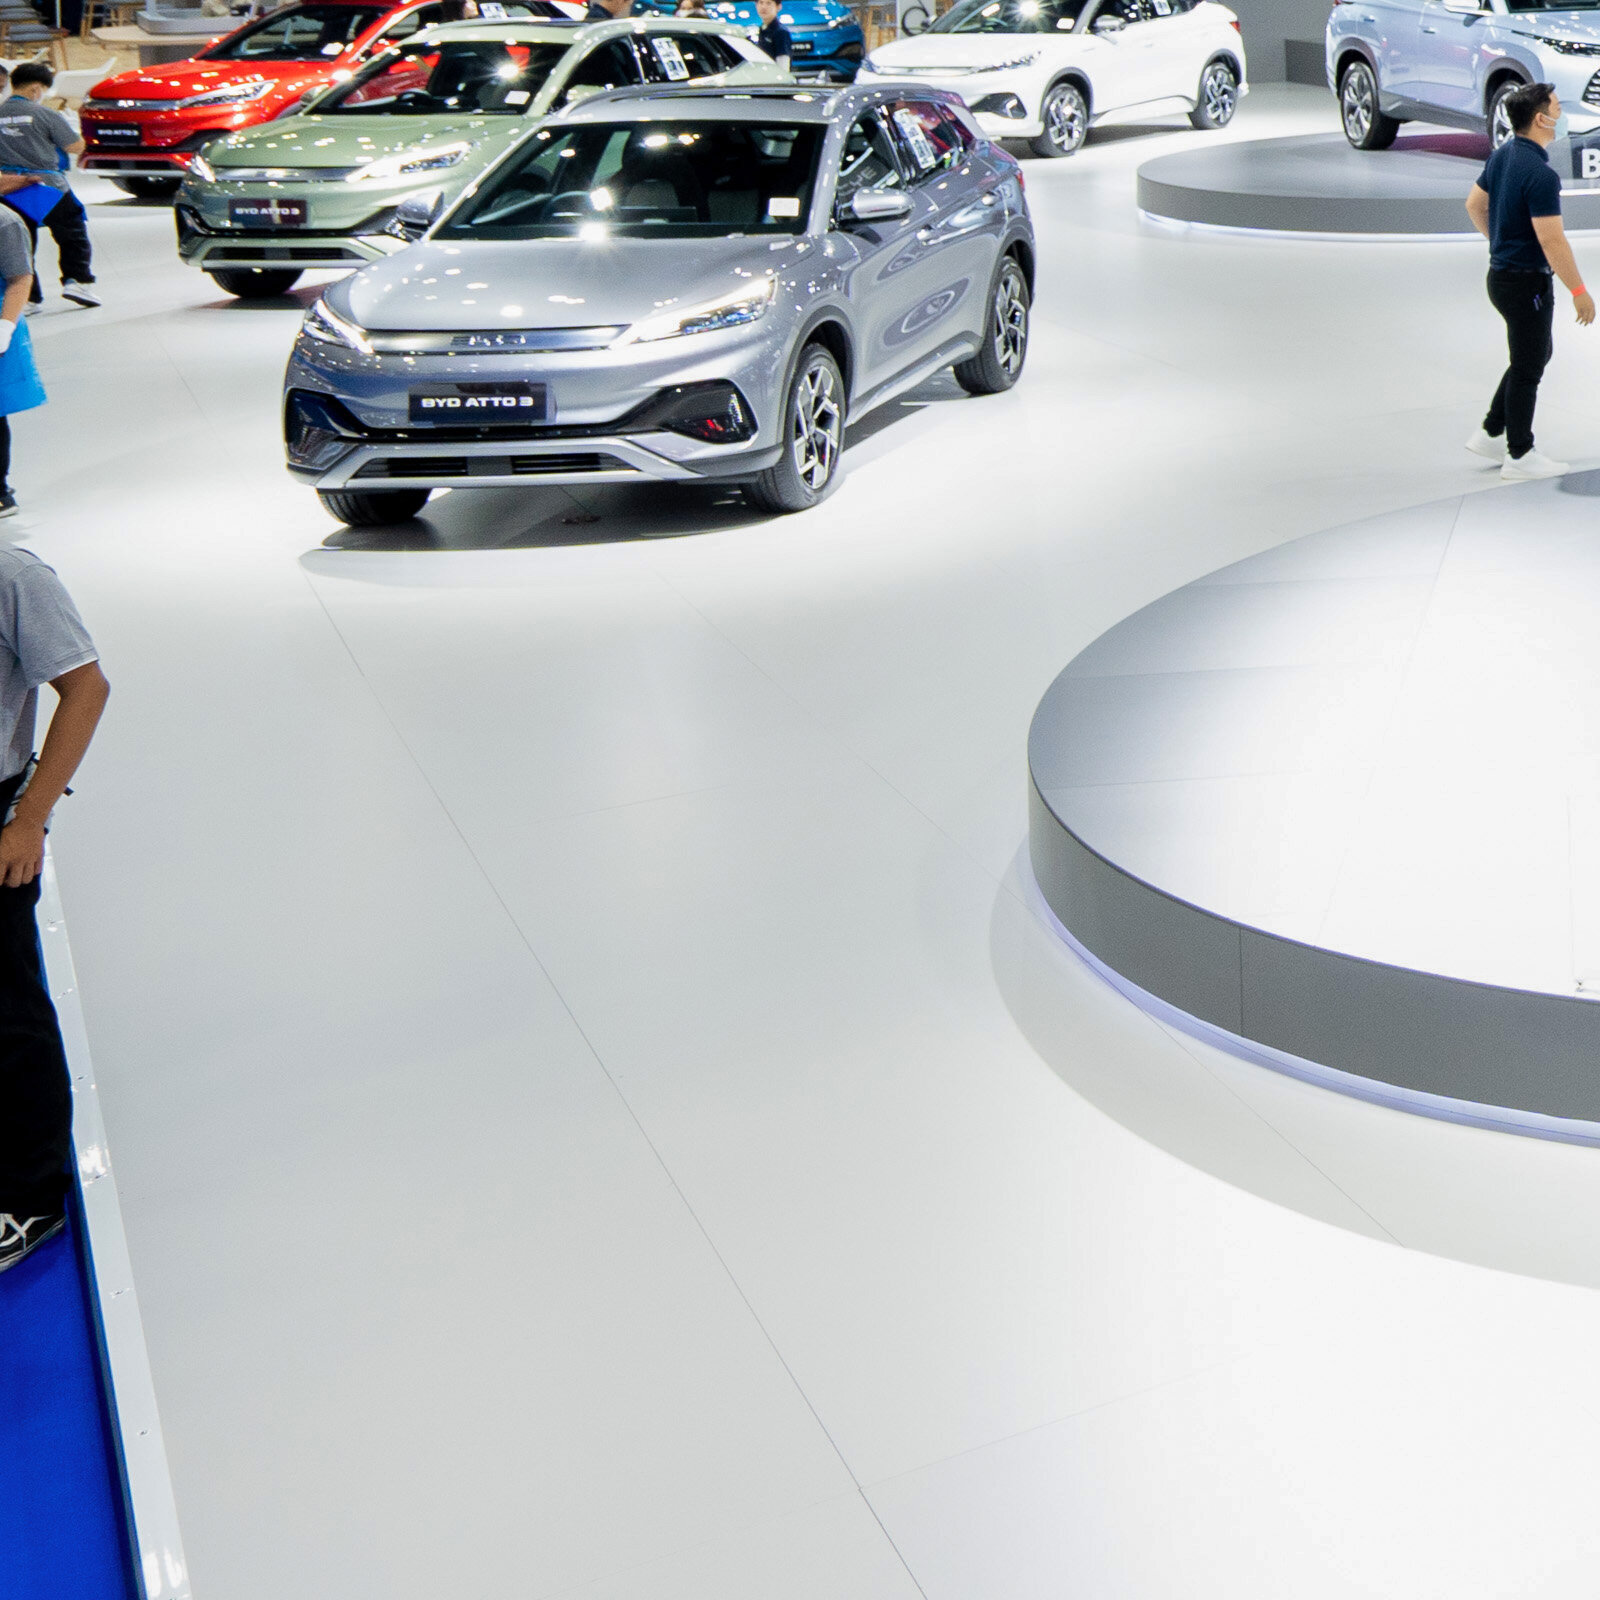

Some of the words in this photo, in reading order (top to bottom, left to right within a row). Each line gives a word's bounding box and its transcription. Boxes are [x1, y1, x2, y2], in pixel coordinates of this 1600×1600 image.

[235, 207, 259, 215] BYD
[260, 207, 290, 215] ATTO
[291, 207, 301, 215] 3
[421, 397, 461, 408] BYD
[465, 396, 516, 408] ATTO
[519, 396, 534, 407] 3
